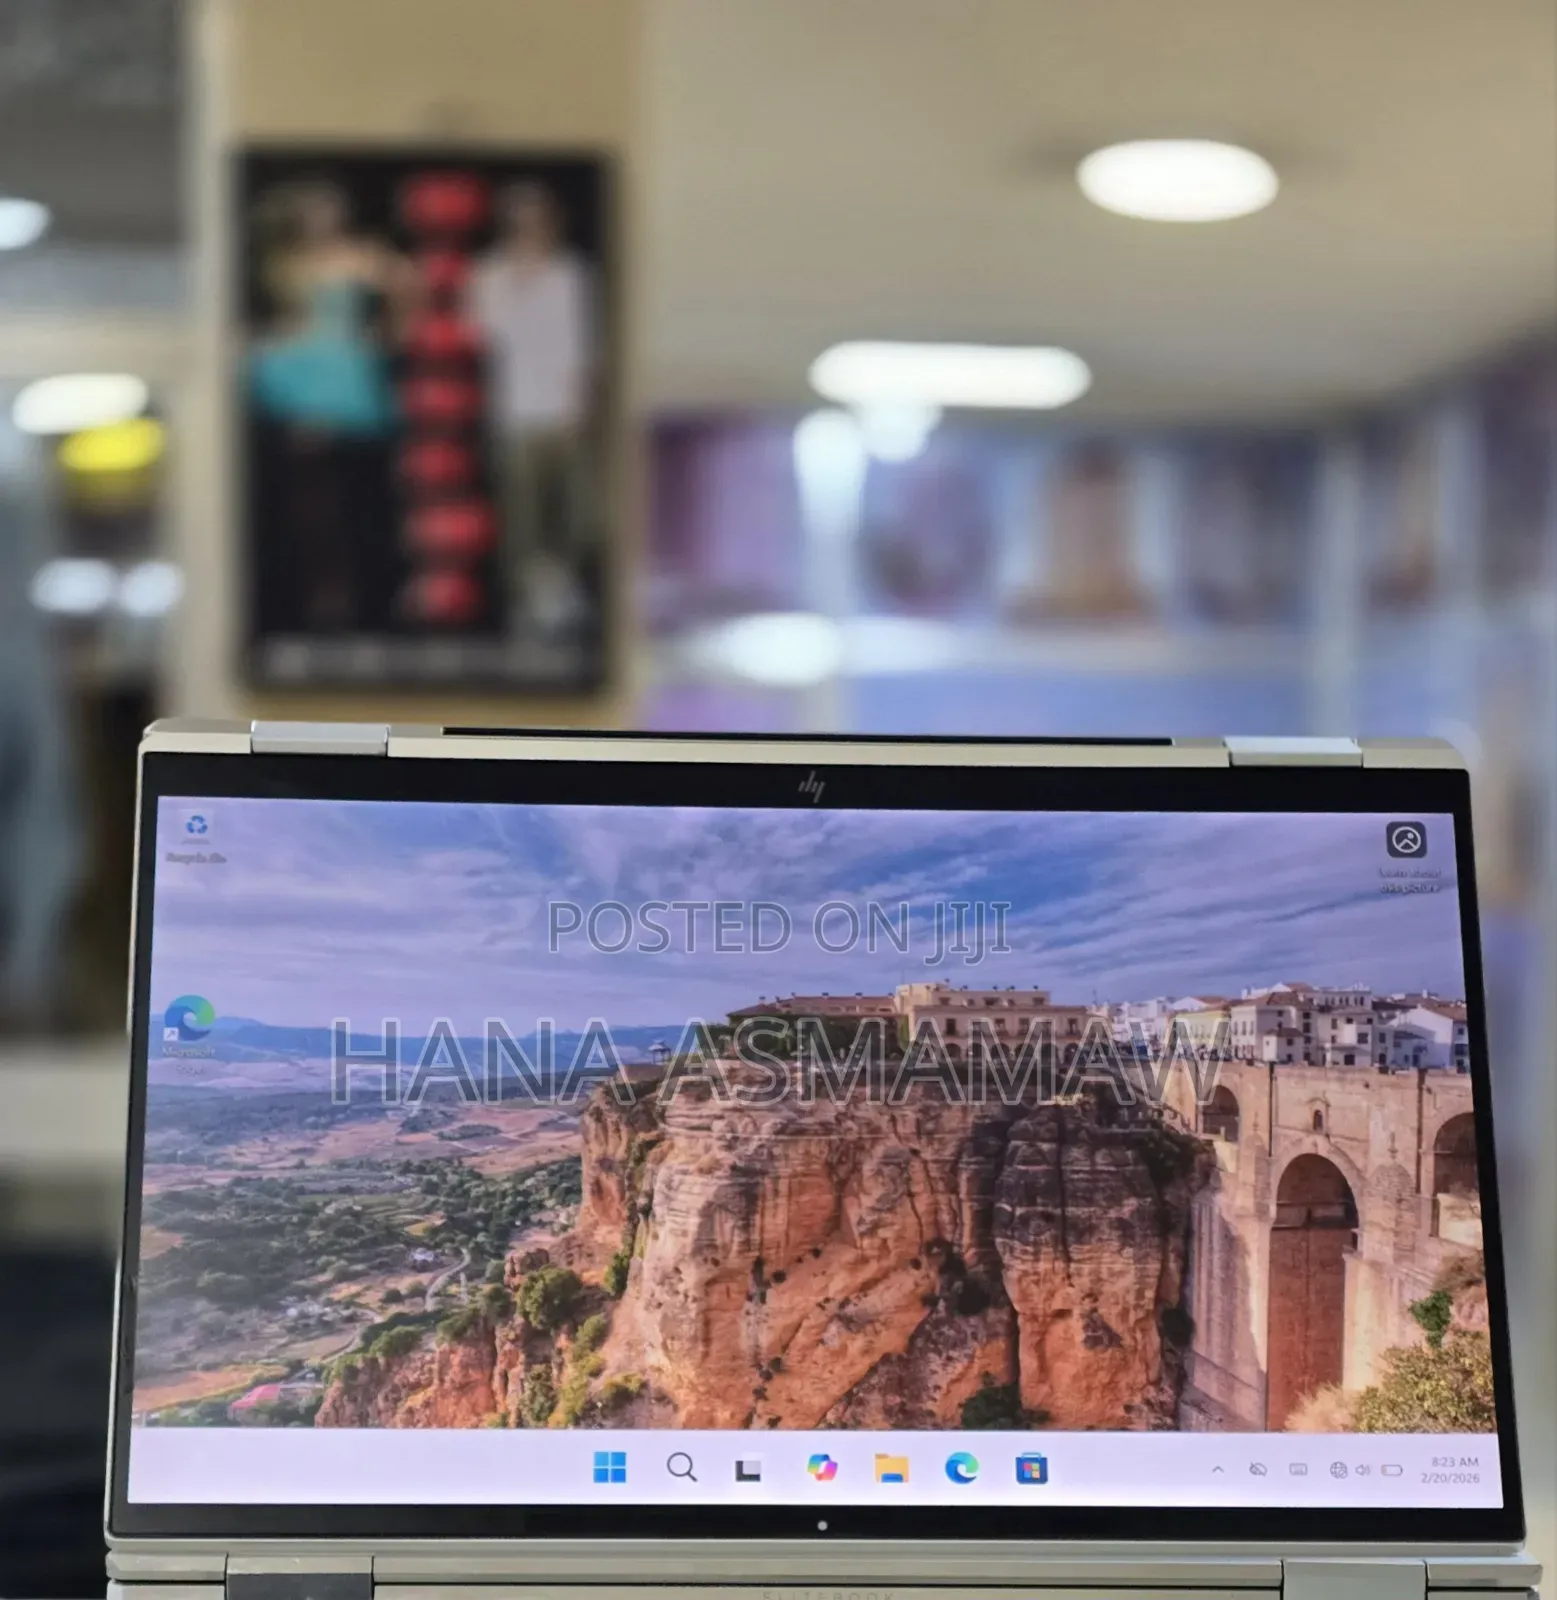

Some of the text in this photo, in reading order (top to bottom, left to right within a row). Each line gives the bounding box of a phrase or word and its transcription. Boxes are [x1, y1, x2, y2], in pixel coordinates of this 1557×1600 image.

[1431, 1457, 1479, 1467] 8:23 AM
[1421, 1473, 1480, 1484] 2/20/2026
